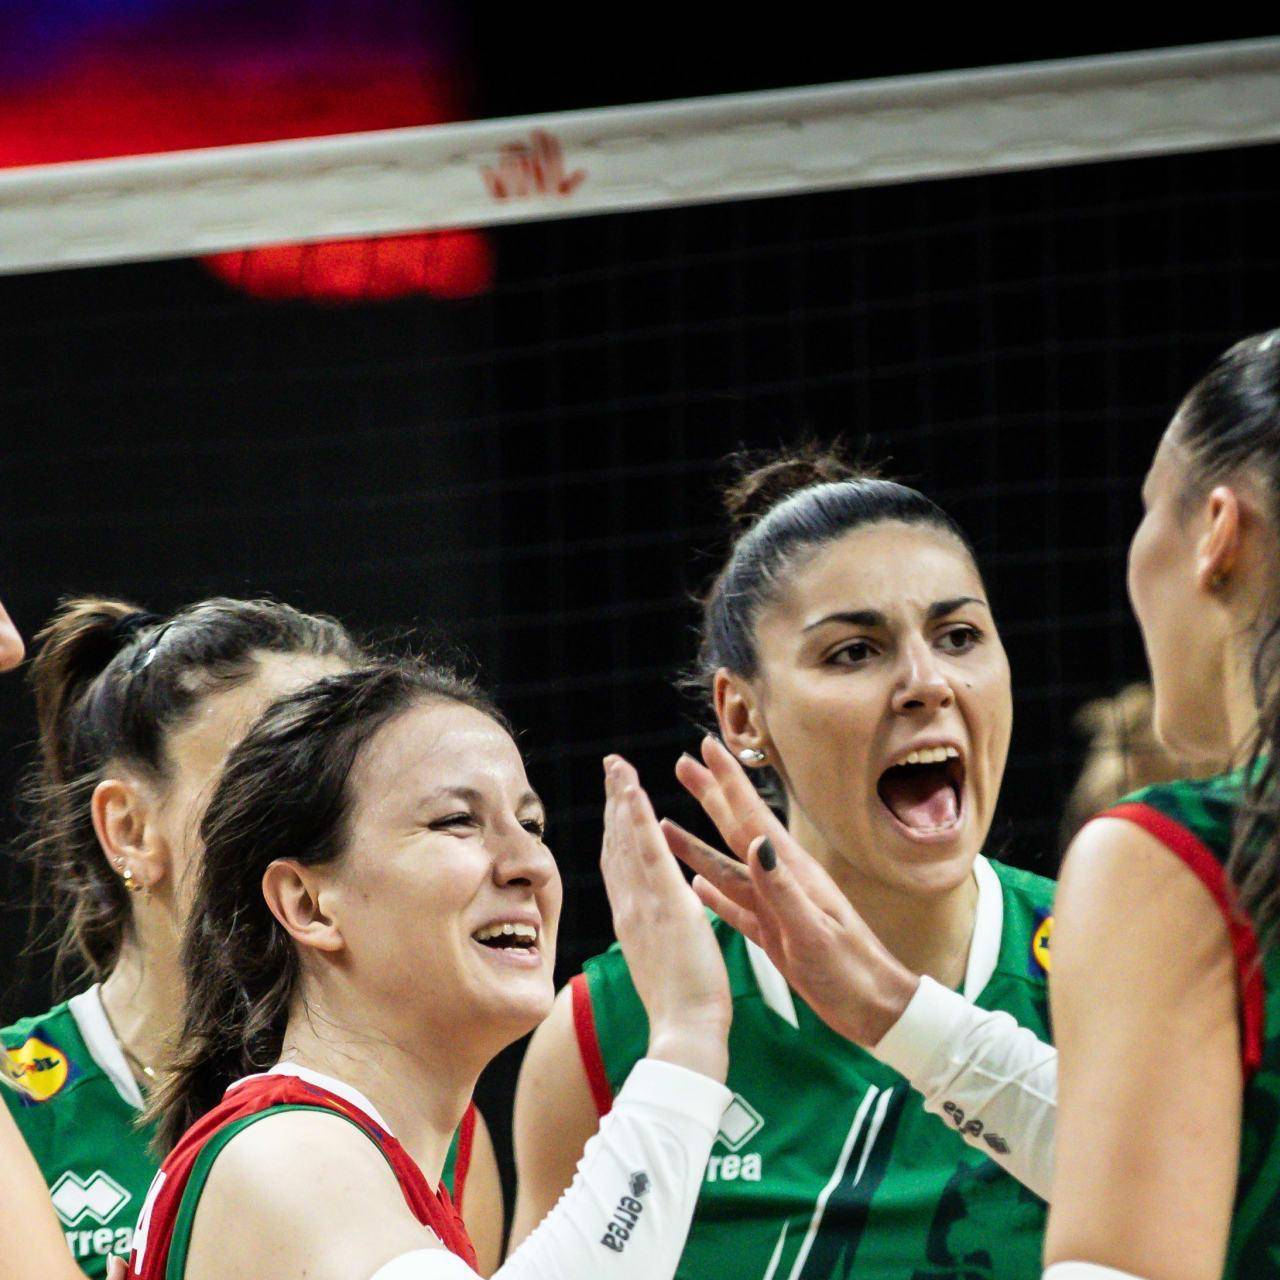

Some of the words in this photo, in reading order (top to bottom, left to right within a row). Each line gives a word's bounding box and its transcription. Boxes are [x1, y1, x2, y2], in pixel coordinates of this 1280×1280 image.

[706, 1152, 762, 1182] rea
[600, 1195, 644, 1254] errea
[64, 1226, 134, 1257] rrea
